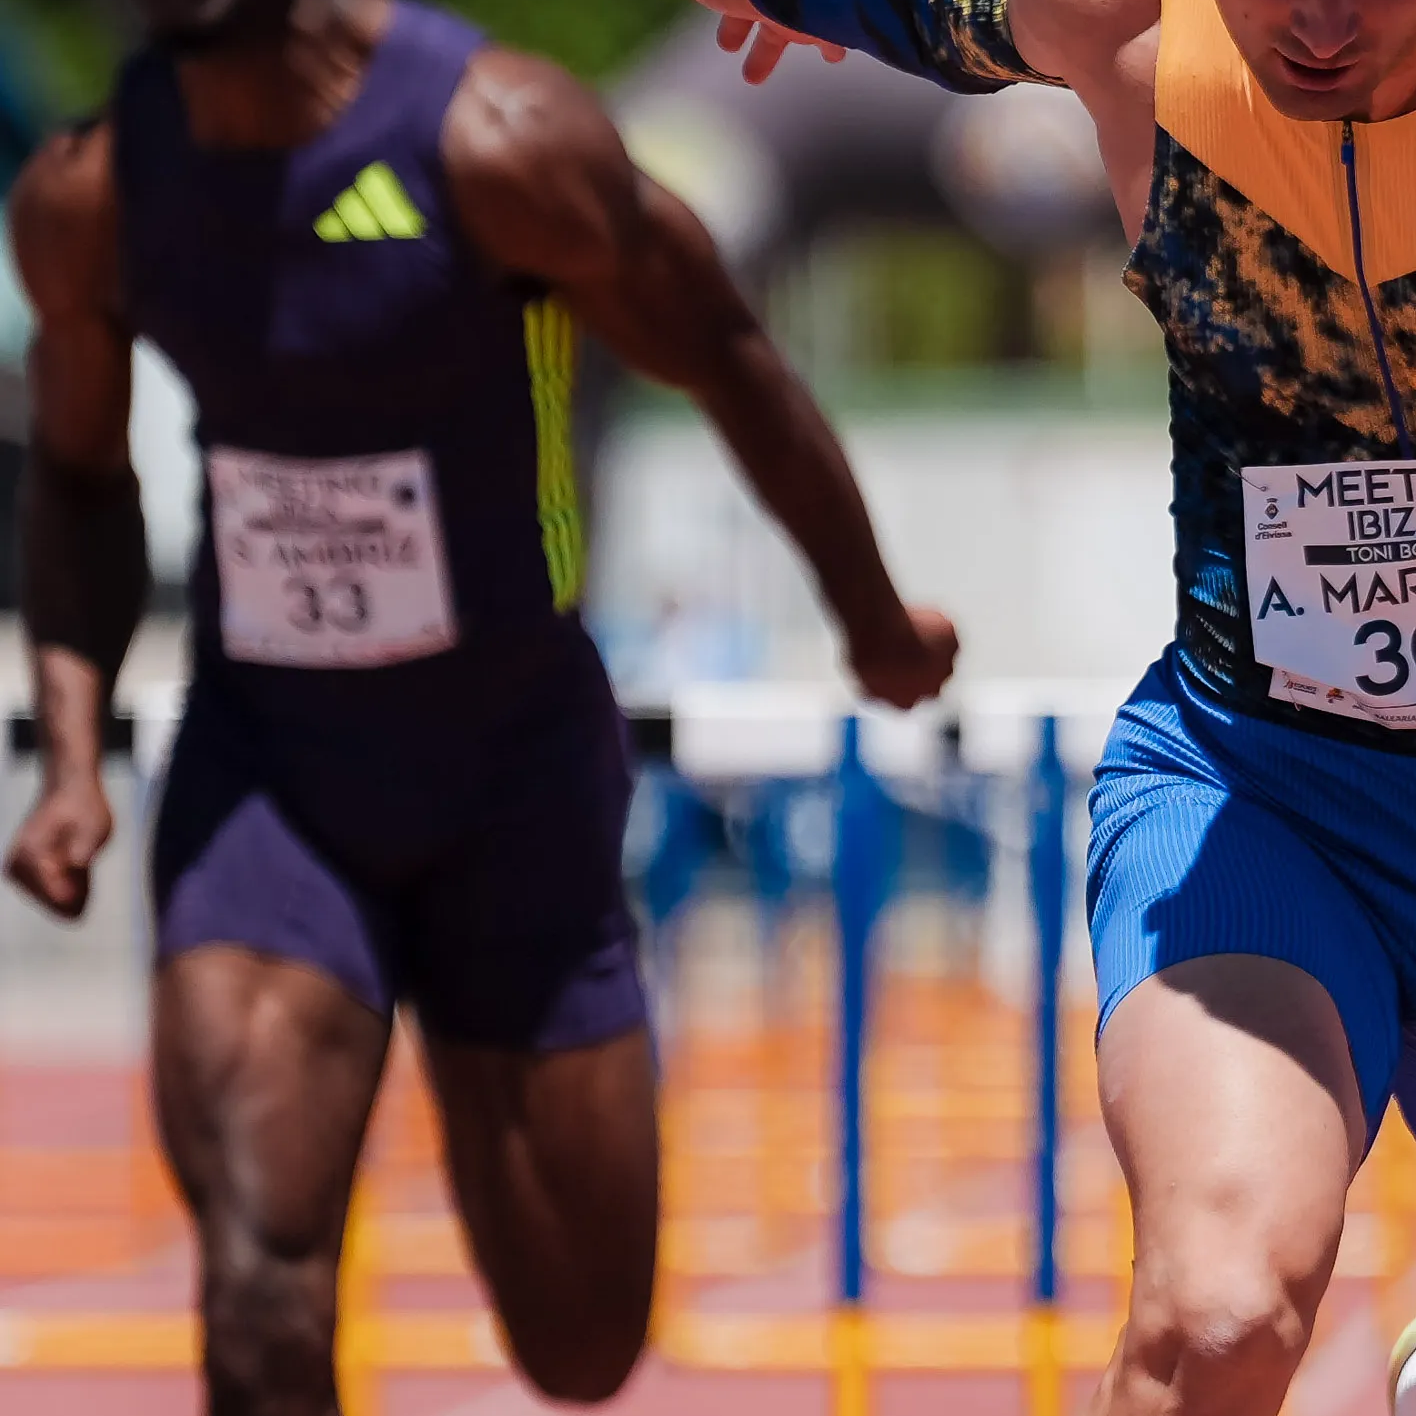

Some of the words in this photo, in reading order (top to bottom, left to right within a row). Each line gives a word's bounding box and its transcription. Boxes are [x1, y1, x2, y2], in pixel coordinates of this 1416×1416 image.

[1257, 521, 1288, 531] Consell
[1346, 544, 1393, 563] TONI
[281, 573, 373, 636] 33
[1257, 576, 1305, 620] A.
